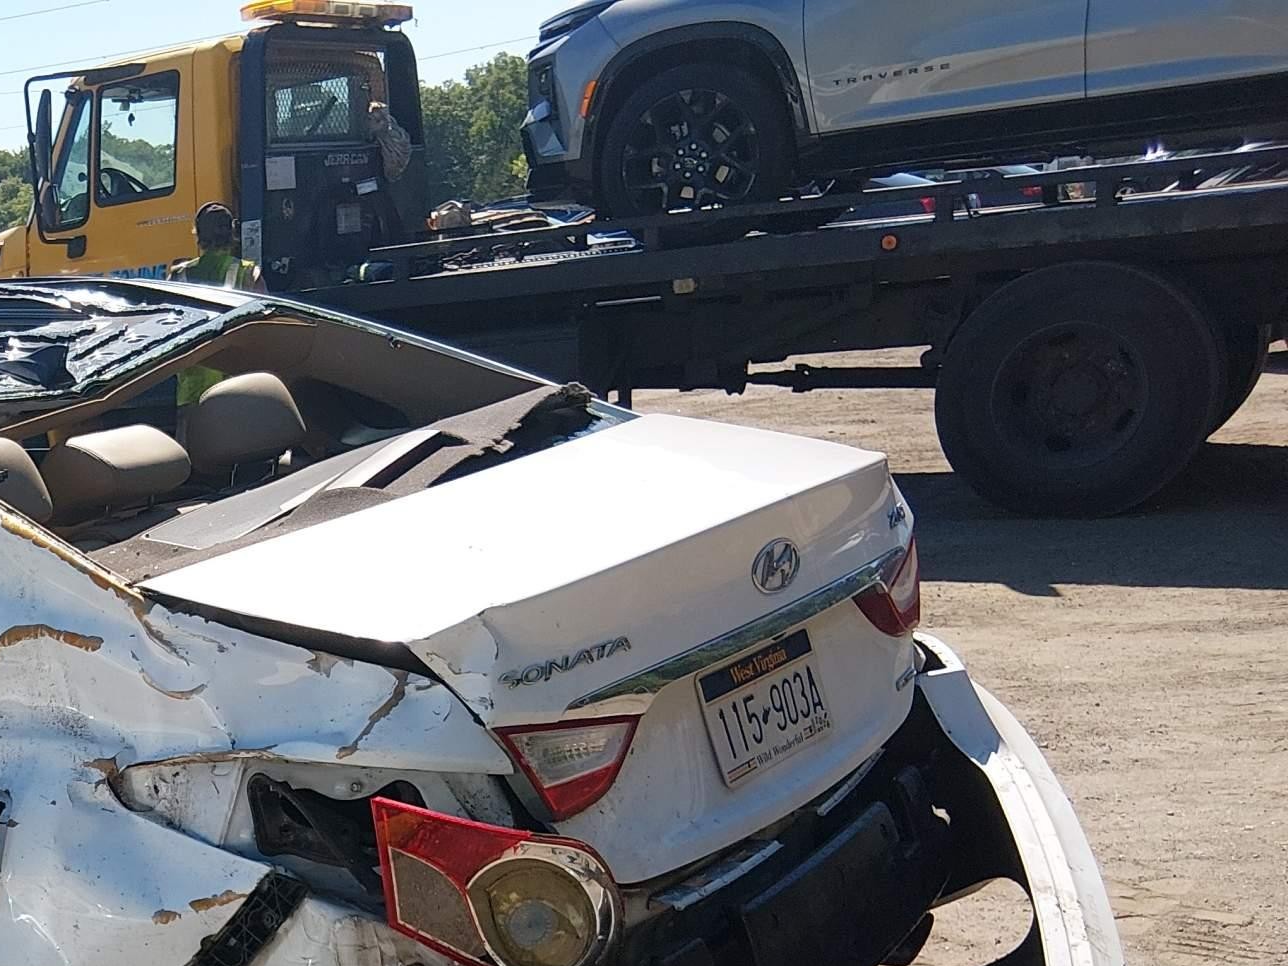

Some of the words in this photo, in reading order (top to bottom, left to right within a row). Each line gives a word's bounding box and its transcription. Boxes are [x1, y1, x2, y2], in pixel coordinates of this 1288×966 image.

[832, 63, 951, 86] TRAVERSE
[497, 635, 632, 690] SONATA
[729, 664, 755, 684] West
[753, 647, 787, 672] Virginia
[772, 732, 804, 757] Wonderful
